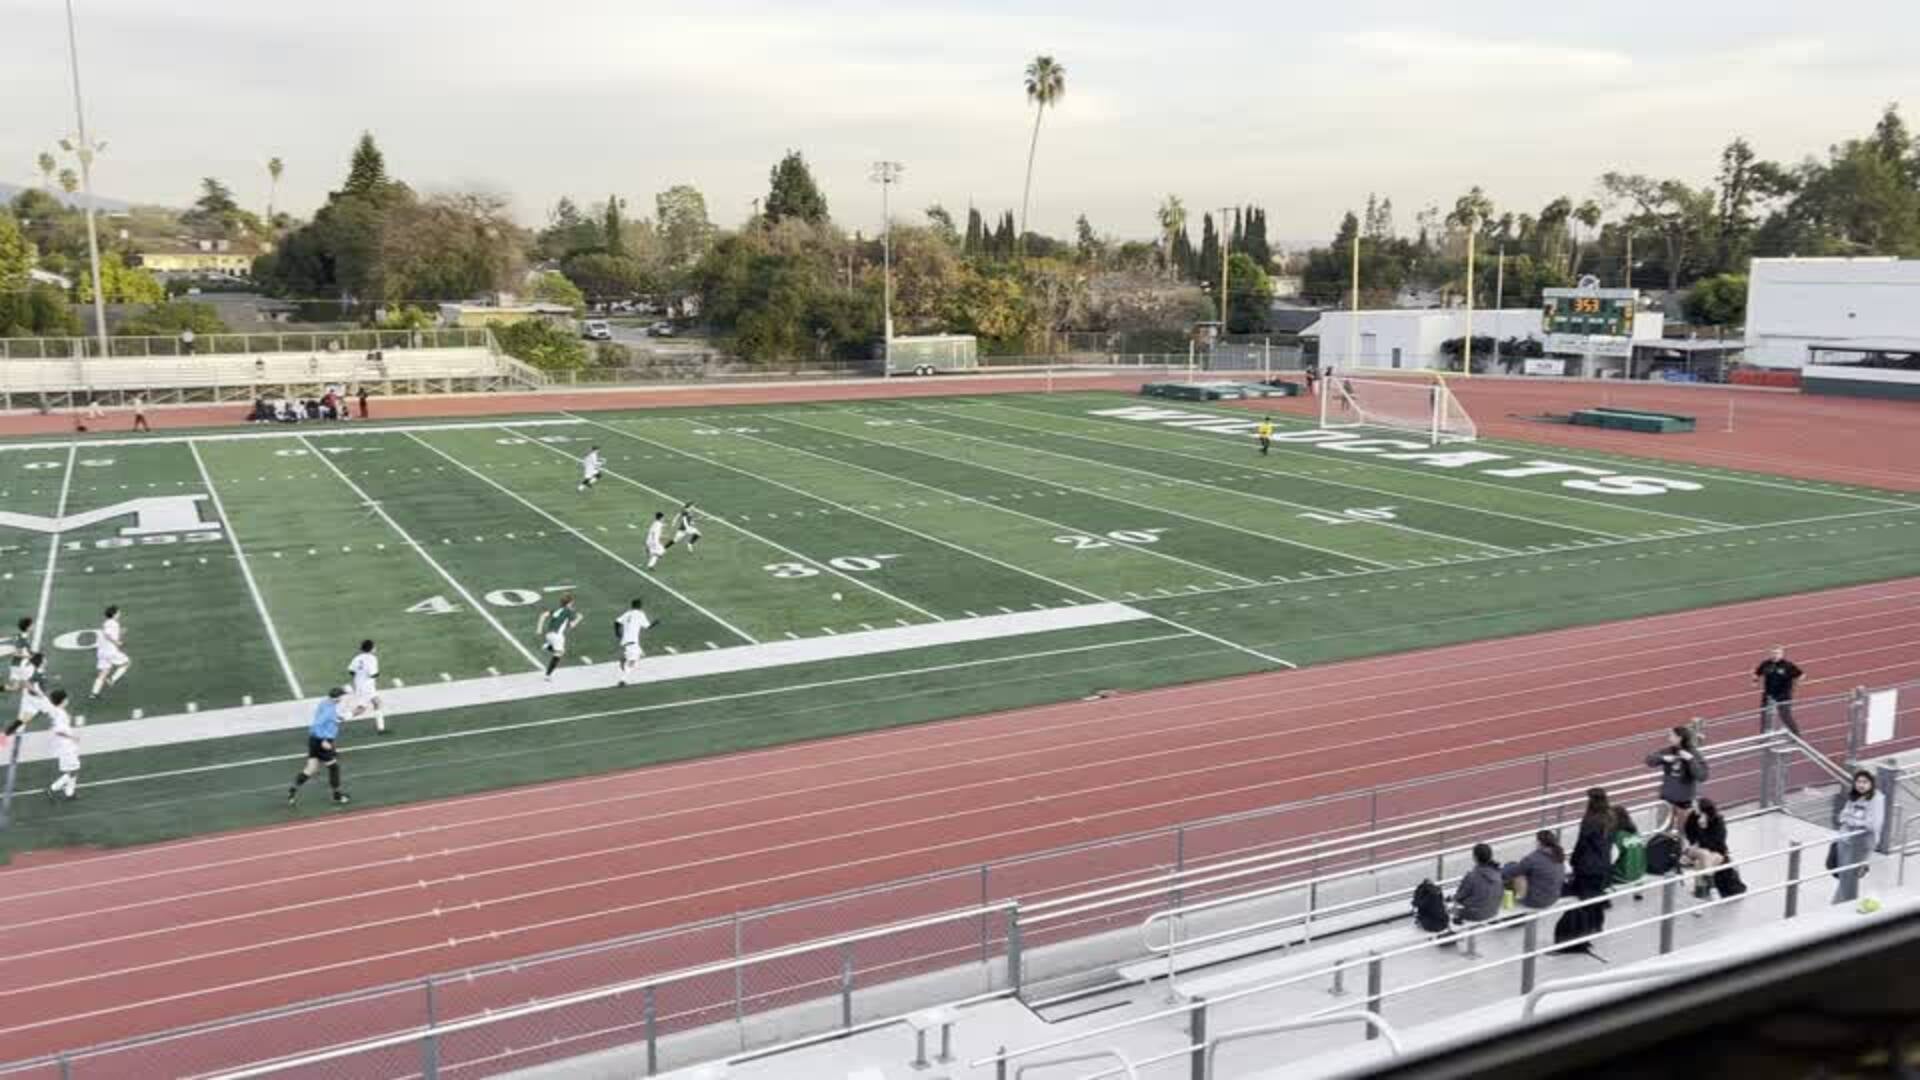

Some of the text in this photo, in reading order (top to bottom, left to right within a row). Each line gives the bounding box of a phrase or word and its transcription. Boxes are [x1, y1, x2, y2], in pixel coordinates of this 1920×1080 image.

[1090, 411, 1705, 494] WILDCATS
[763, 556, 881, 578] 30
[404, 589, 542, 614] 40
